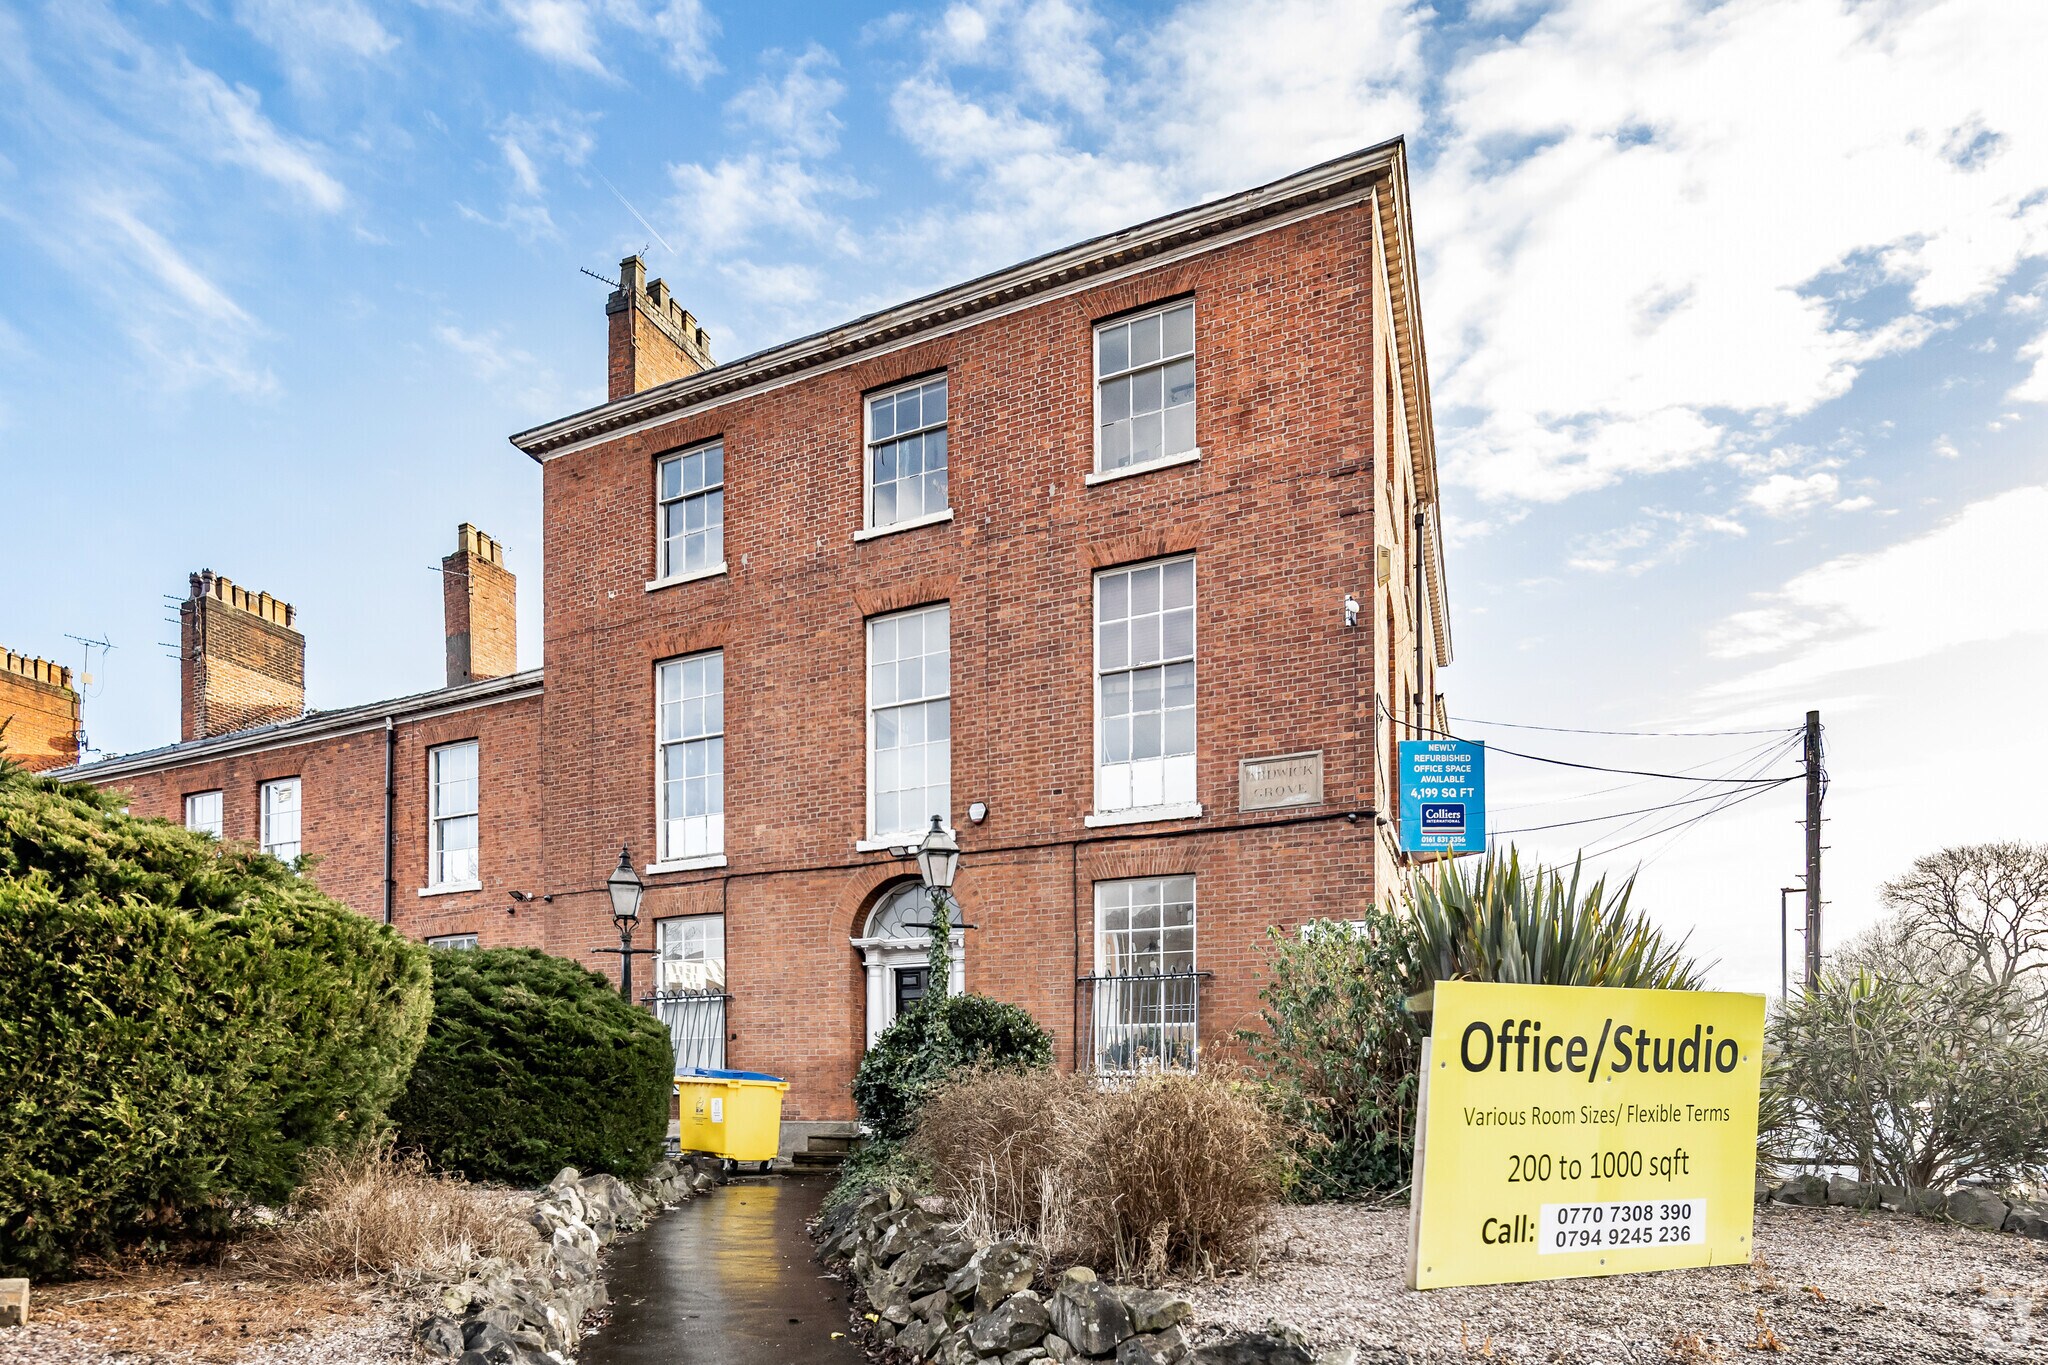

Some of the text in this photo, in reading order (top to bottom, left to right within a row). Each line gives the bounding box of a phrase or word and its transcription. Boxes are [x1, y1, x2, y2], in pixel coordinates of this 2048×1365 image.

[1414, 754, 1471, 762] REFURBISHED
[1253, 783, 1308, 797] GROVE
[1420, 775, 1465, 783] AVAILABLE
[1411, 788, 1474, 800] 4,199 SQ FT
[1425, 809, 1461, 819] Colliers
[1460, 1018, 1739, 1083] Office/Studio
[1463, 1103, 1730, 1127] Various Room Sizes/ Flexible Terms
[1507, 1147, 1690, 1182] 200 to 1000 sqft
[1557, 1203, 1692, 1225] 0770 7308 390
[1481, 1214, 1536, 1245] Call:
[1556, 1225, 1692, 1248] 0794 9245 236
